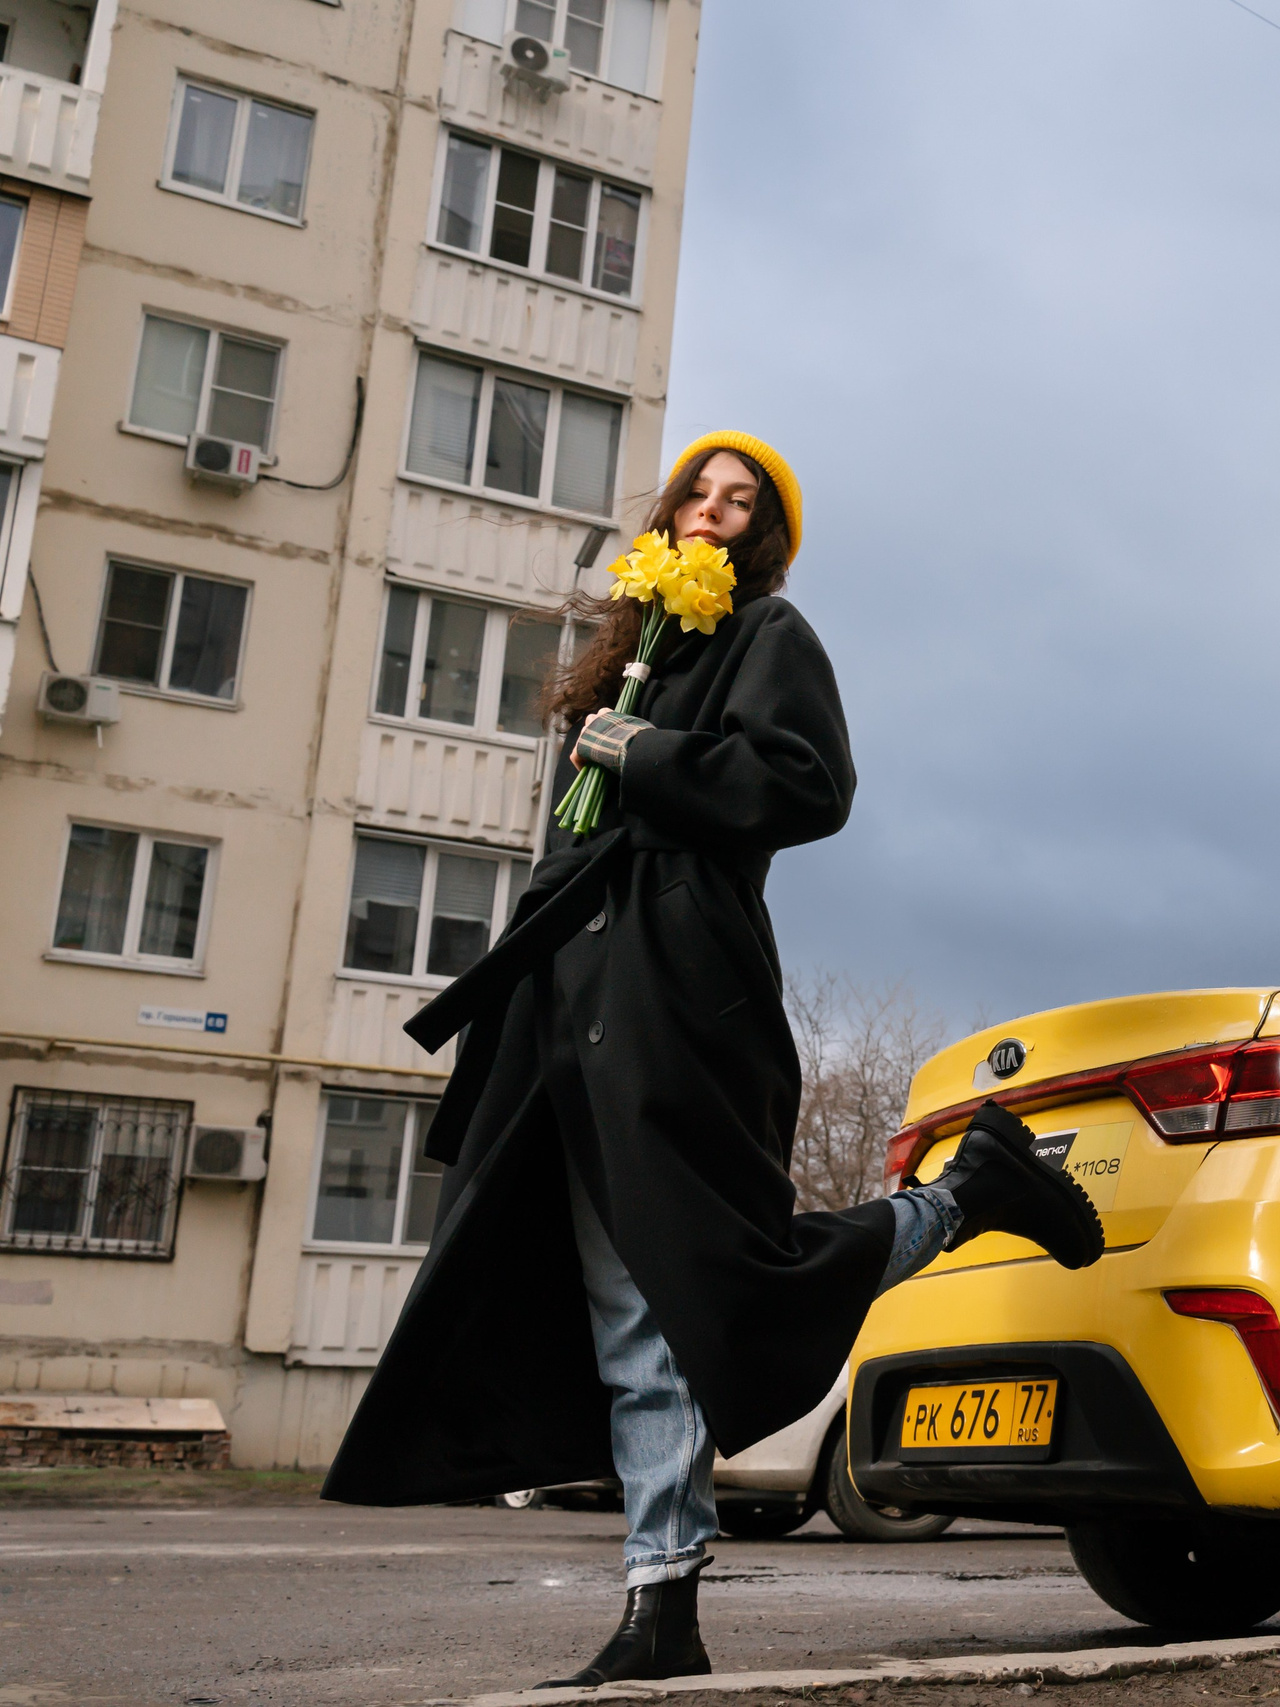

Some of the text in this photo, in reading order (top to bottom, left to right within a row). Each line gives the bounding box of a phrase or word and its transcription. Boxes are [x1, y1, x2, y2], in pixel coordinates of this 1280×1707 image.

[992, 1047, 1018, 1072] KIA
[950, 1388, 1001, 1440] 676
[1019, 1383, 1050, 1425] 77
[1017, 1427, 1040, 1442] RUS
